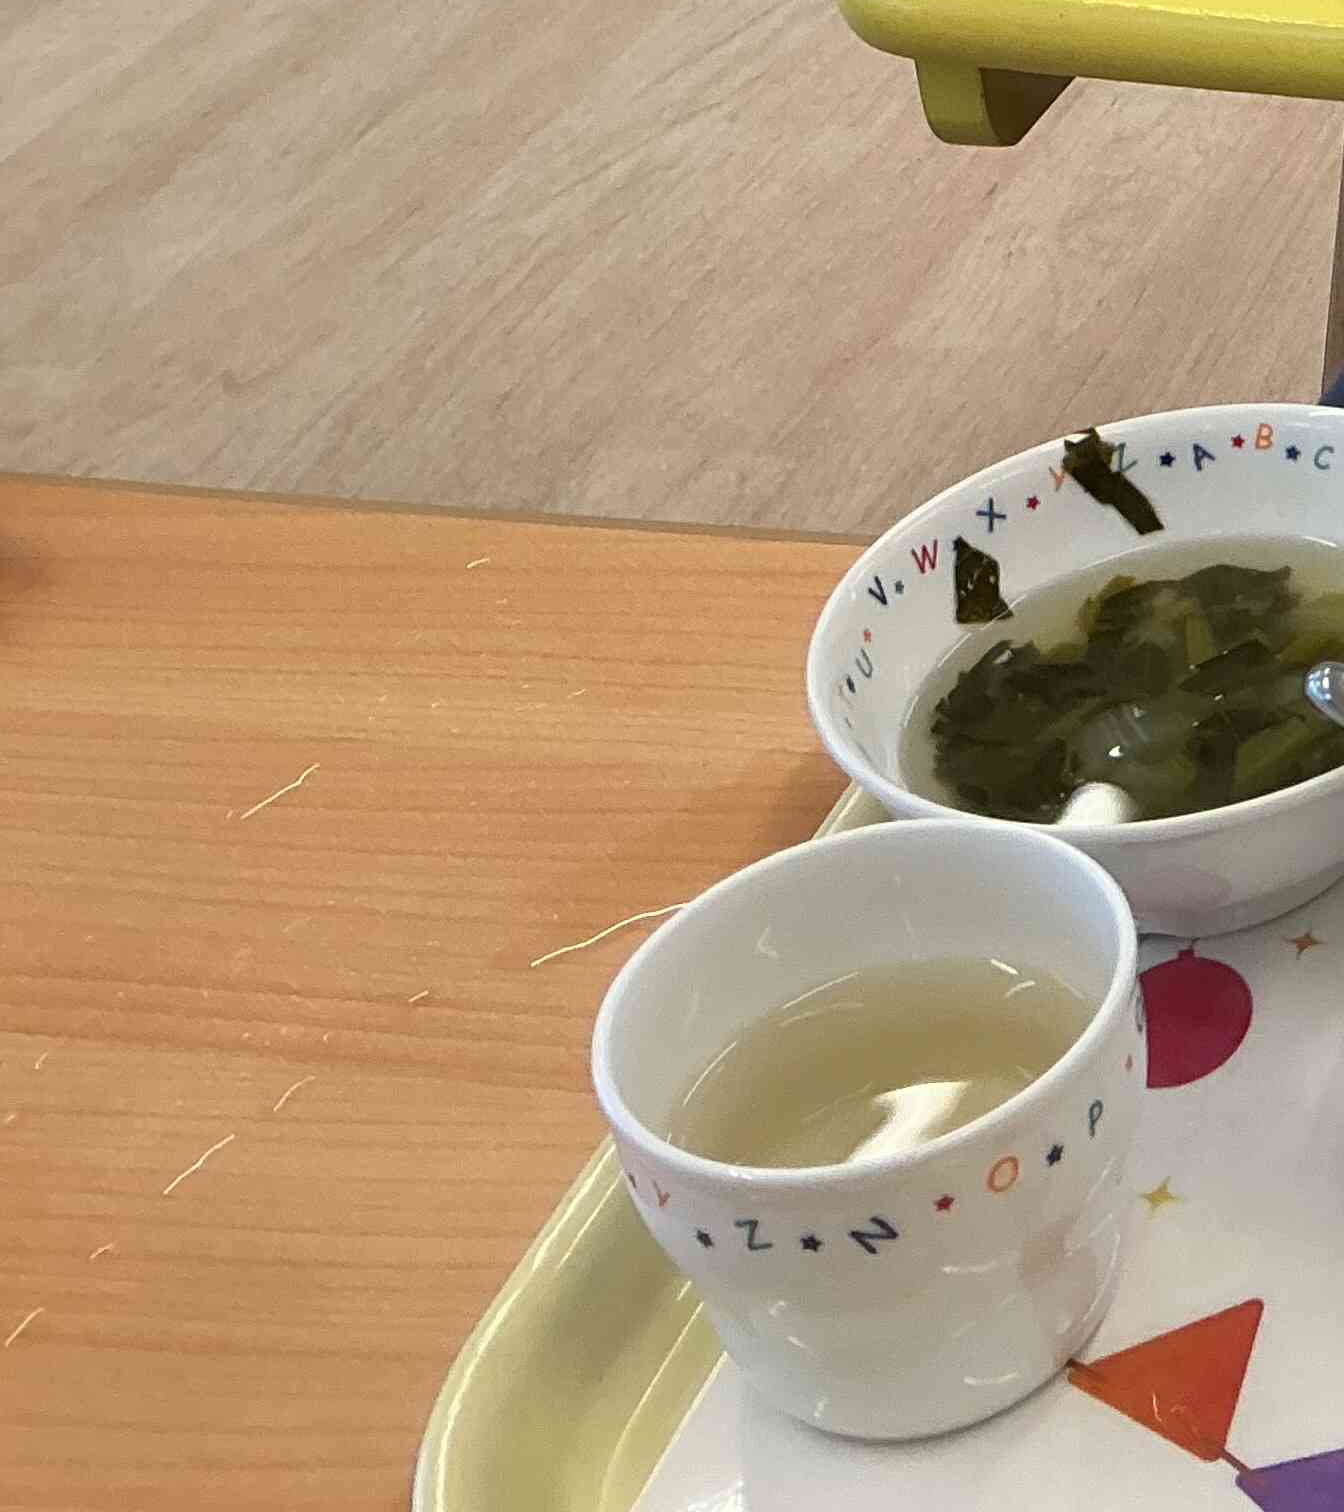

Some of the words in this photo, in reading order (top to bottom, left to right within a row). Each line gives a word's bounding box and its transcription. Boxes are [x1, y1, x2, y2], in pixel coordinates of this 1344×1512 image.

[855, 648, 874, 678] U
[868, 576, 888, 606] V
[911, 539, 938, 574] W
[976, 497, 1007, 532] X
[1193, 443, 1215, 471] A
[1254, 423, 1274, 450] B
[1313, 446, 1335, 470] C
[733, 1218, 773, 1250] Z
[987, 1156, 1020, 1193] O
[1088, 1099, 1104, 1138] P
